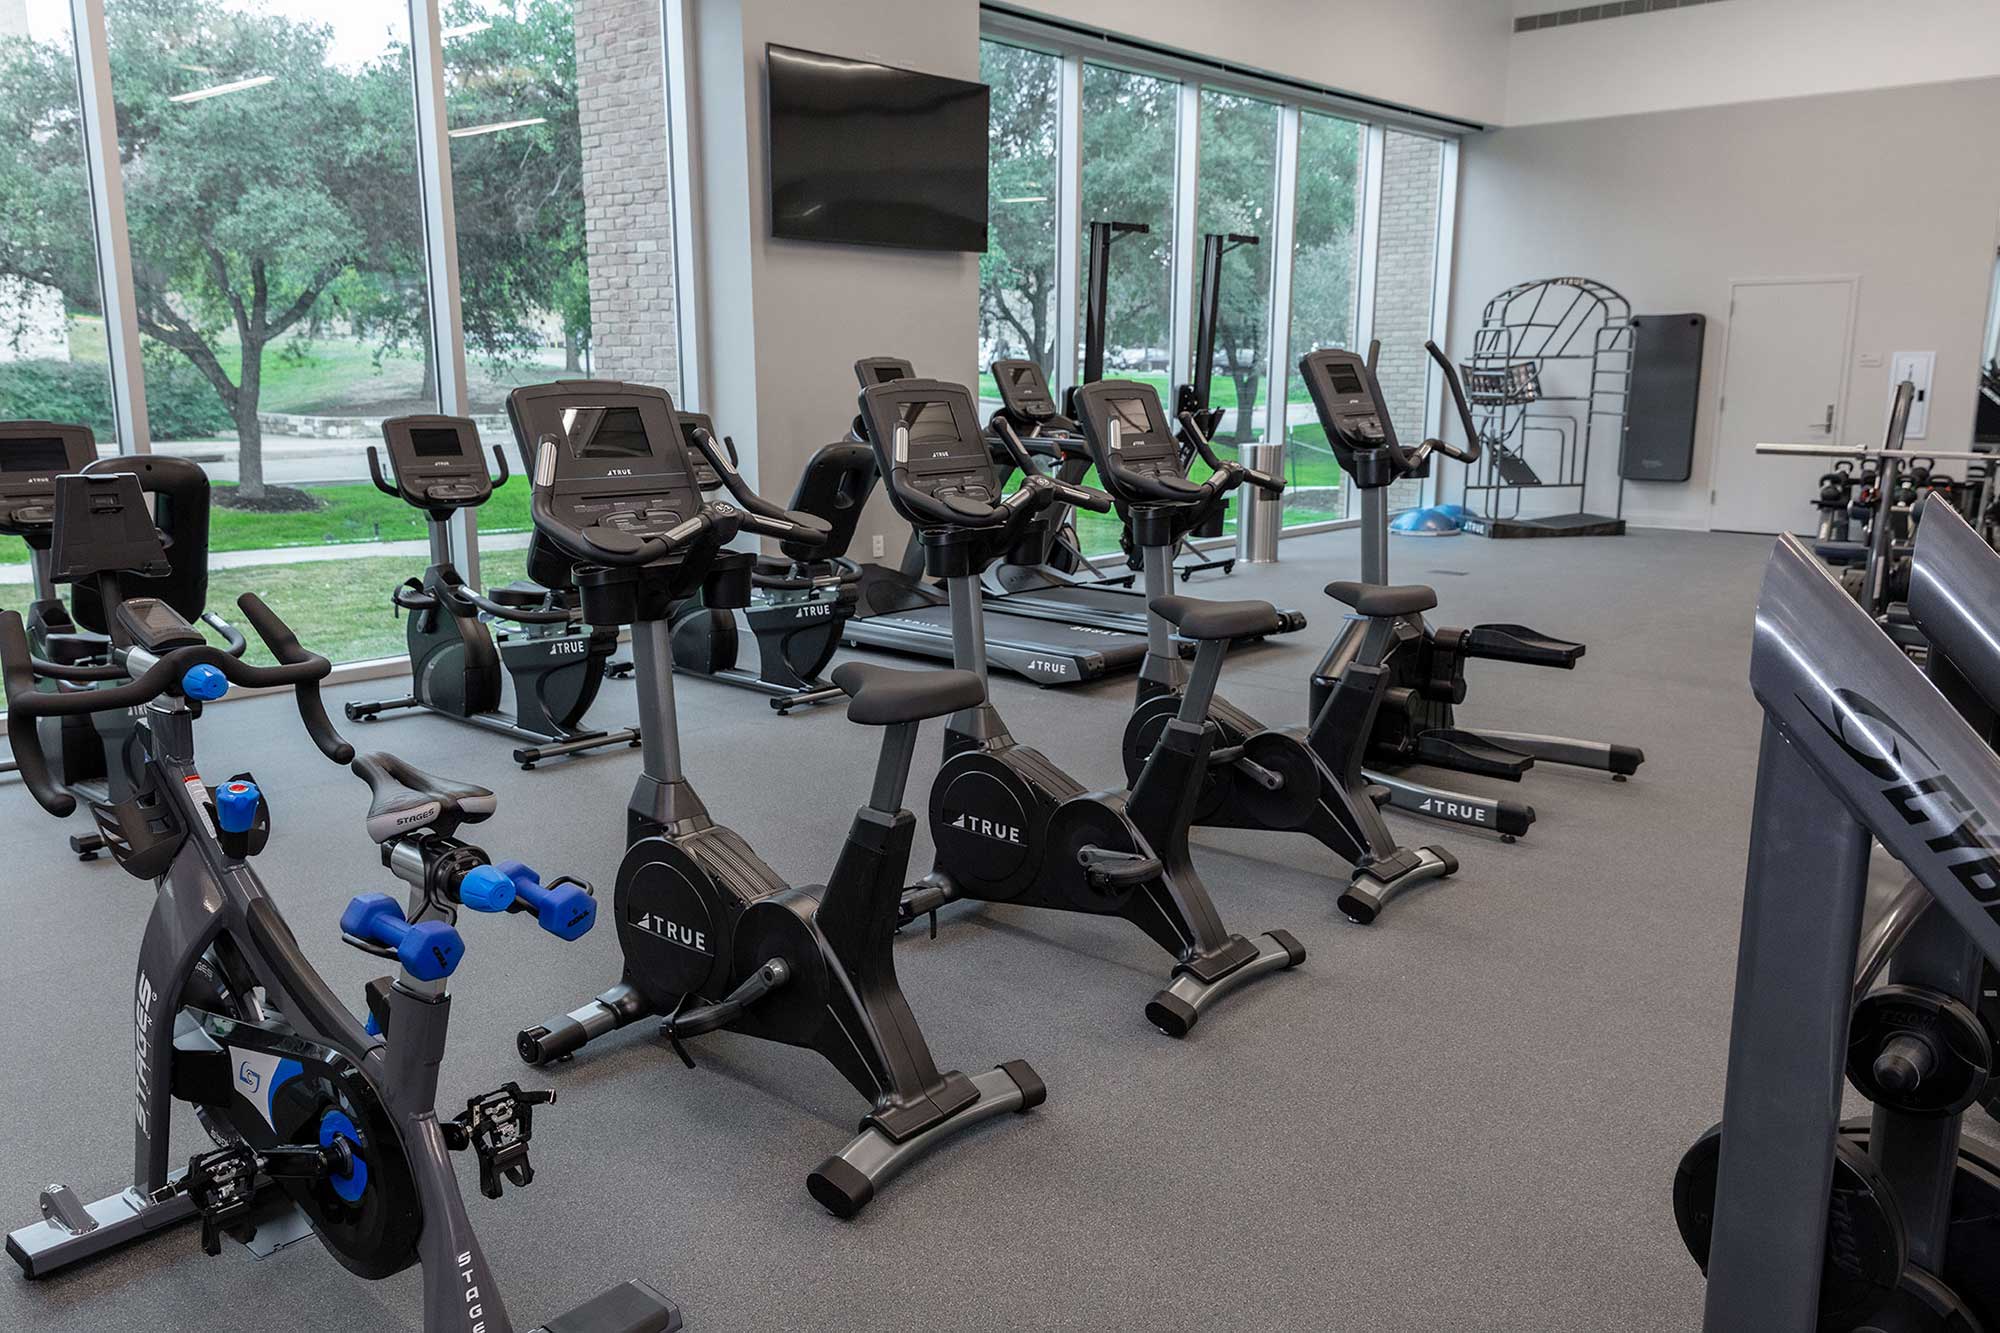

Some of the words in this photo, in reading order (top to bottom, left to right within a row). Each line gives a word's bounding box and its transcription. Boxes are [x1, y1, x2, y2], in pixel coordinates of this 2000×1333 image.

[803, 604, 831, 617] TRUE
[556, 640, 585, 654] TRUE
[1036, 660, 1067, 674] TRUE
[396, 808, 434, 825] STAGES
[1434, 799, 1486, 822] TRUE
[968, 815, 1020, 843] TRUE
[1880, 774, 2000, 927] CYB
[653, 914, 706, 951] TRUE
[136, 969, 152, 1133] STAGES
[458, 1250, 486, 1333] STAGE
